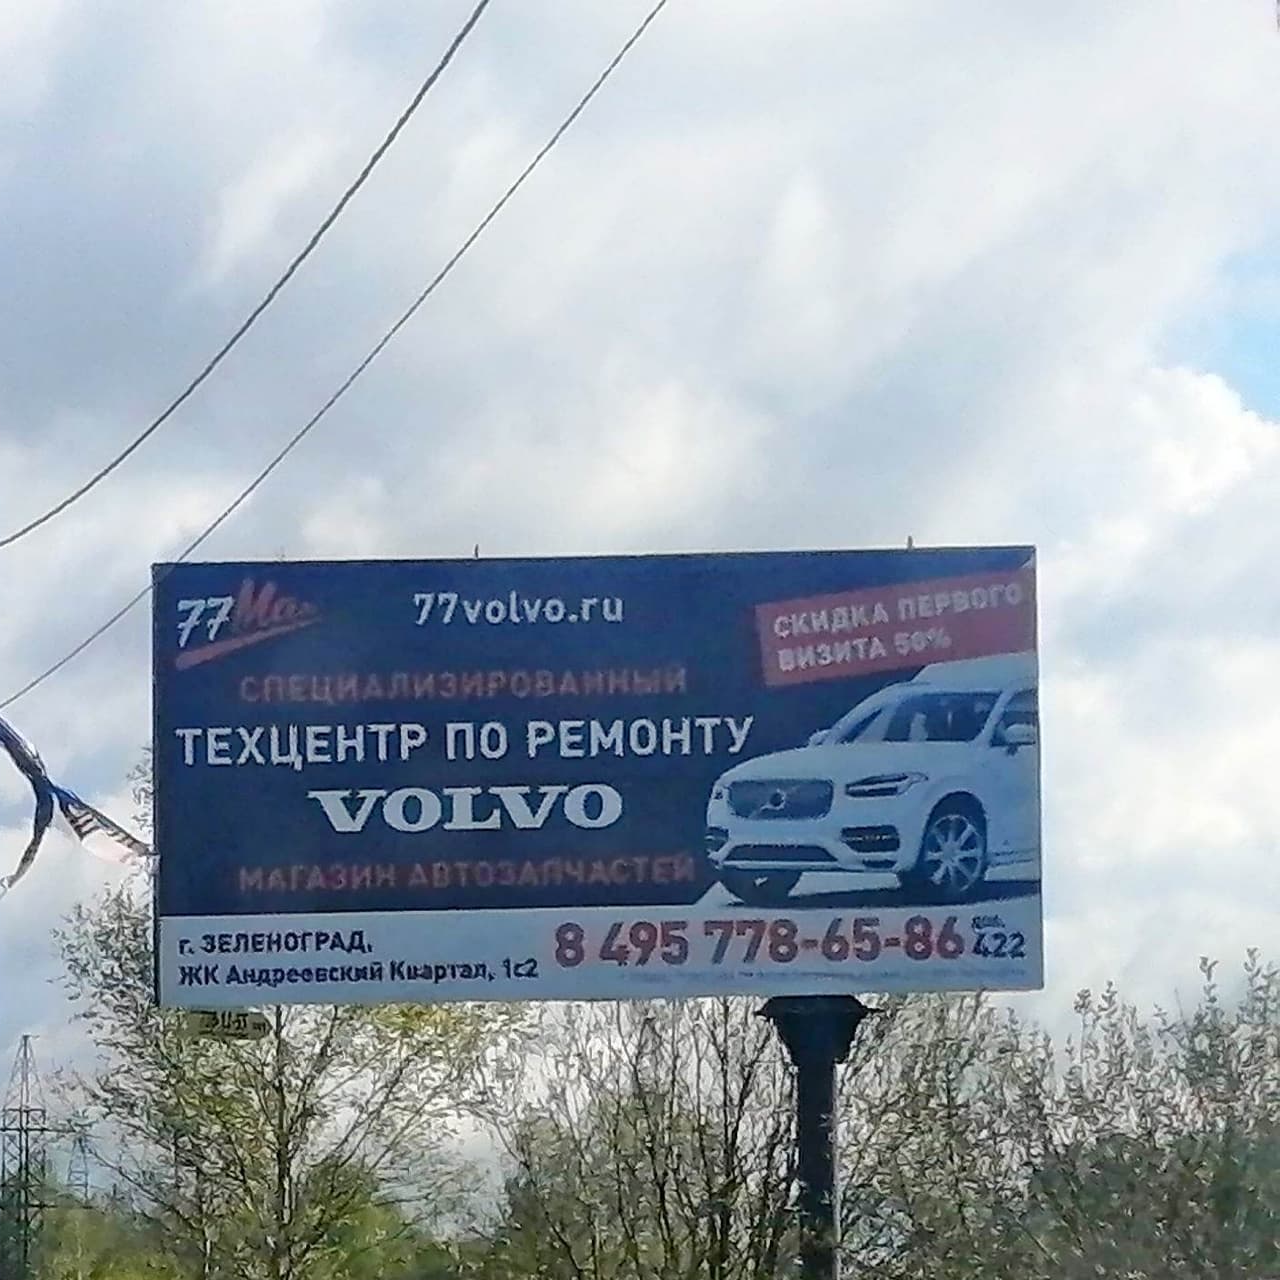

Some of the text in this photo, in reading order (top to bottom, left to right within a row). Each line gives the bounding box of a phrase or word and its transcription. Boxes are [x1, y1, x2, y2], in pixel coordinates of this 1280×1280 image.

[413, 589, 624, 626] 77volvo.ru
[773, 583, 1022, 639] СКИДКА ПЕРВОГО
[777, 636, 887, 673] ВИЗИТА
[240, 664, 689, 705] СПЕЦИАЛИЗИРОВАННЫЙ
[175, 715, 755, 771] ТЕХЦЕНТР ПО РЕМОНТУ
[307, 783, 623, 832] VOLVO
[239, 854, 697, 891] МАГАЗИН АВТОЗАПЧАСТЕЙ
[178, 929, 373, 955] г. ЗЕЛЕНОГРАД,
[554, 914, 966, 969] 8 495 778-65-86
[972, 930, 1026, 960] 422
[178, 965, 220, 986] ЖК
[225, 961, 383, 988] Андреевский
